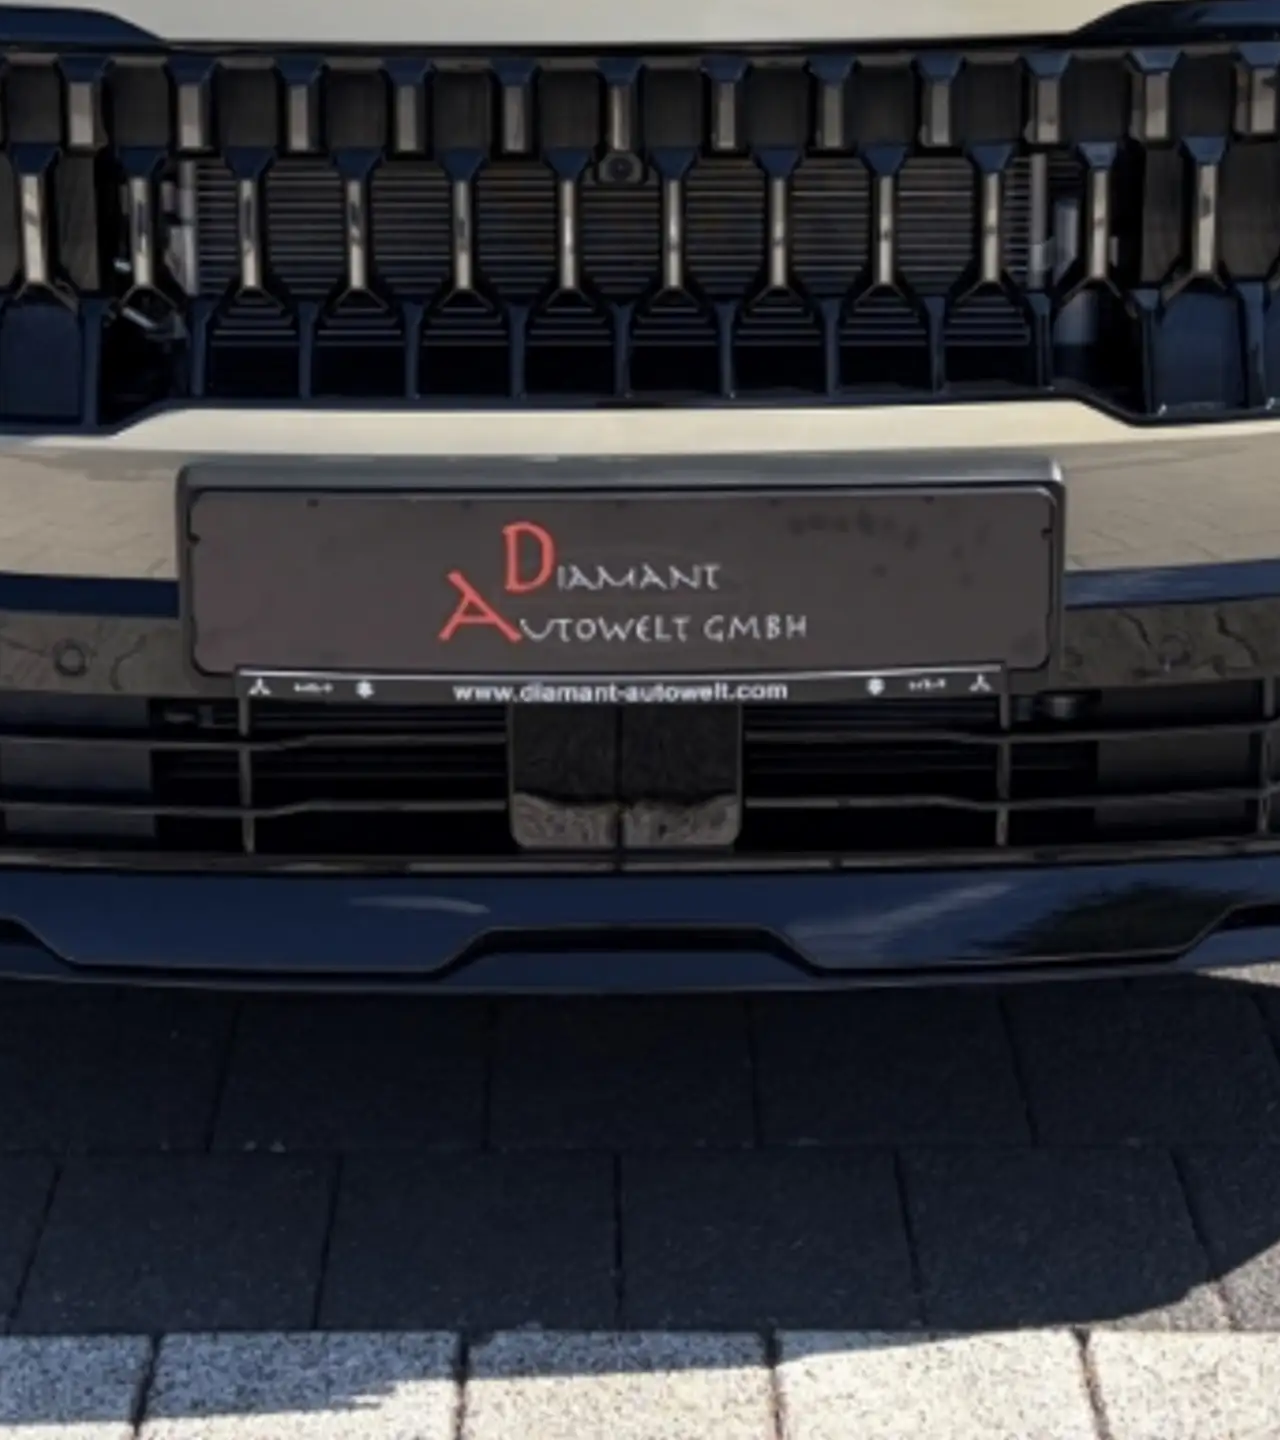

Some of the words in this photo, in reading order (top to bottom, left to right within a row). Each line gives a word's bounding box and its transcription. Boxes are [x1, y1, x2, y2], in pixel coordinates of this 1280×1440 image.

[501, 520, 721, 595] DIAMANT
[438, 569, 691, 643] AUTOWELT
[703, 614, 807, 643] GMBH
[453, 679, 788, 703] www.diamant-autowelt.com
